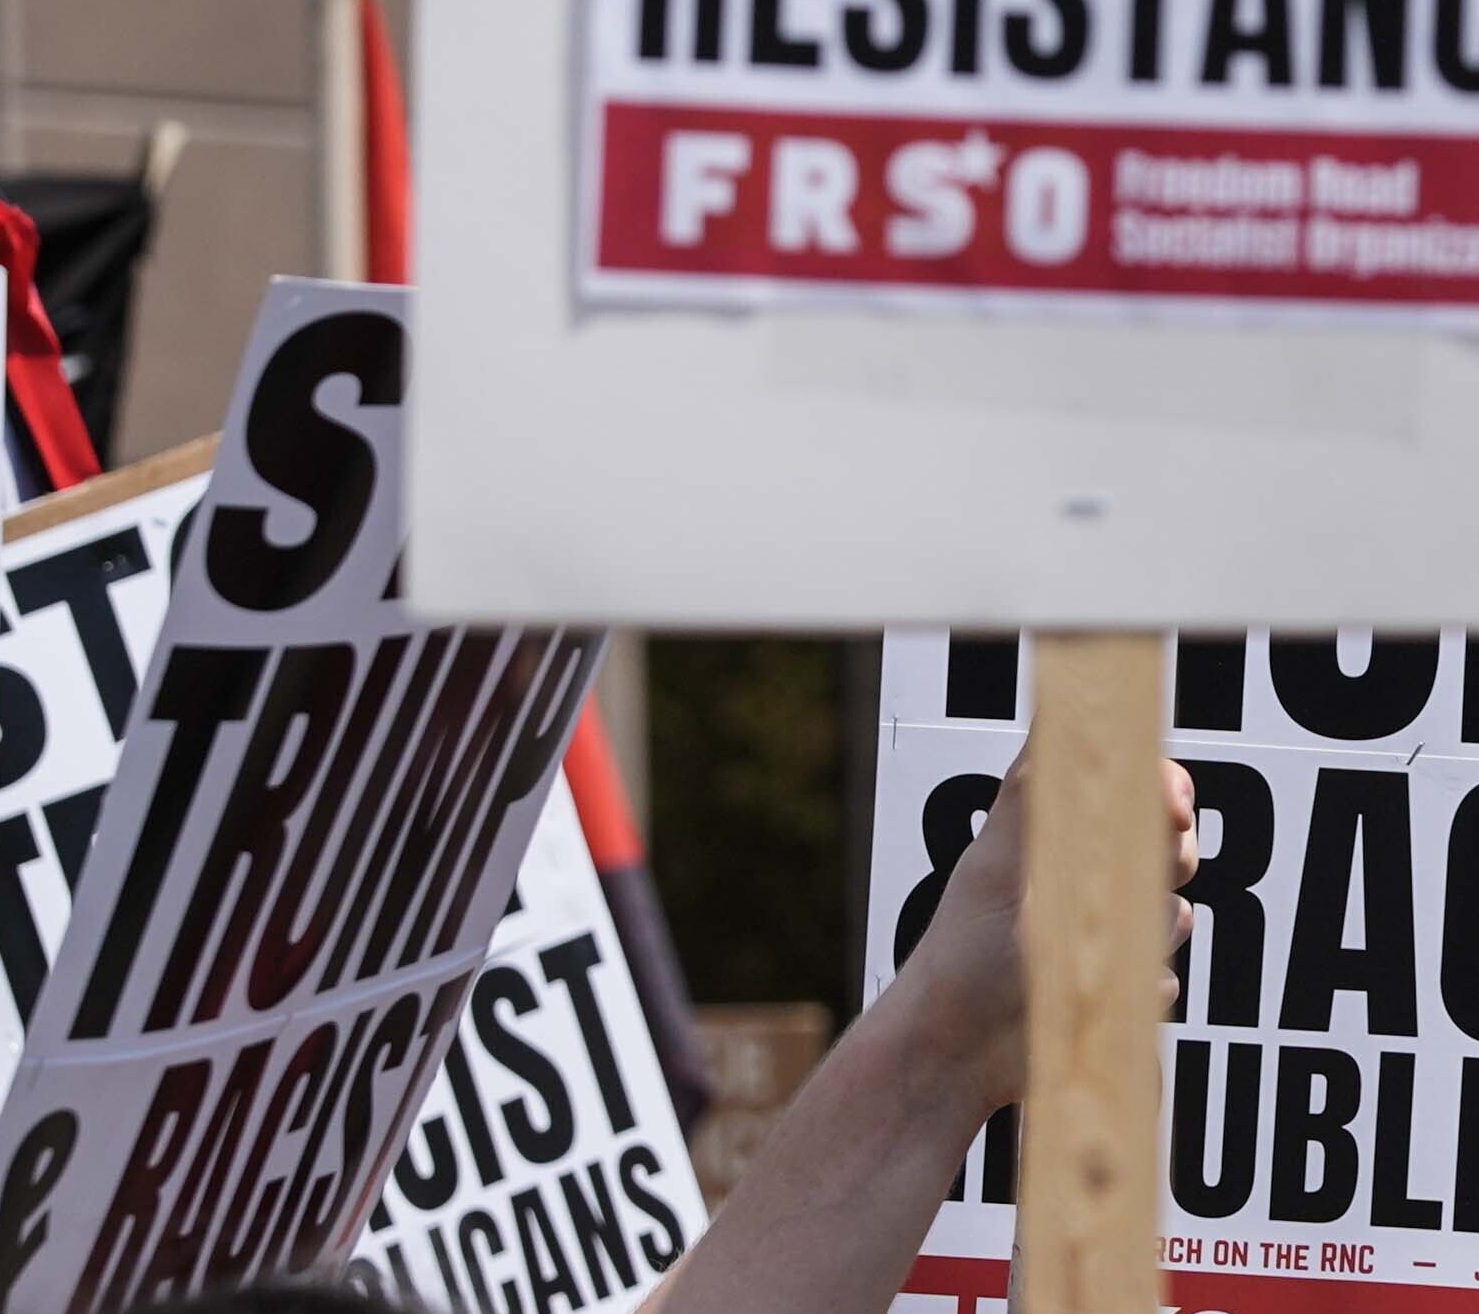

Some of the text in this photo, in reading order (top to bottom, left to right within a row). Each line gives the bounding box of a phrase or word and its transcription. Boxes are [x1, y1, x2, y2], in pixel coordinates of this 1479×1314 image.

[69, 625, 611, 1041] TRUMP
[1155, 1236, 1203, 1267] RCH
[1212, 1239, 1252, 1267] ON
[1258, 1241, 1310, 1271] THE
[1320, 1243, 1376, 1275] RNC
